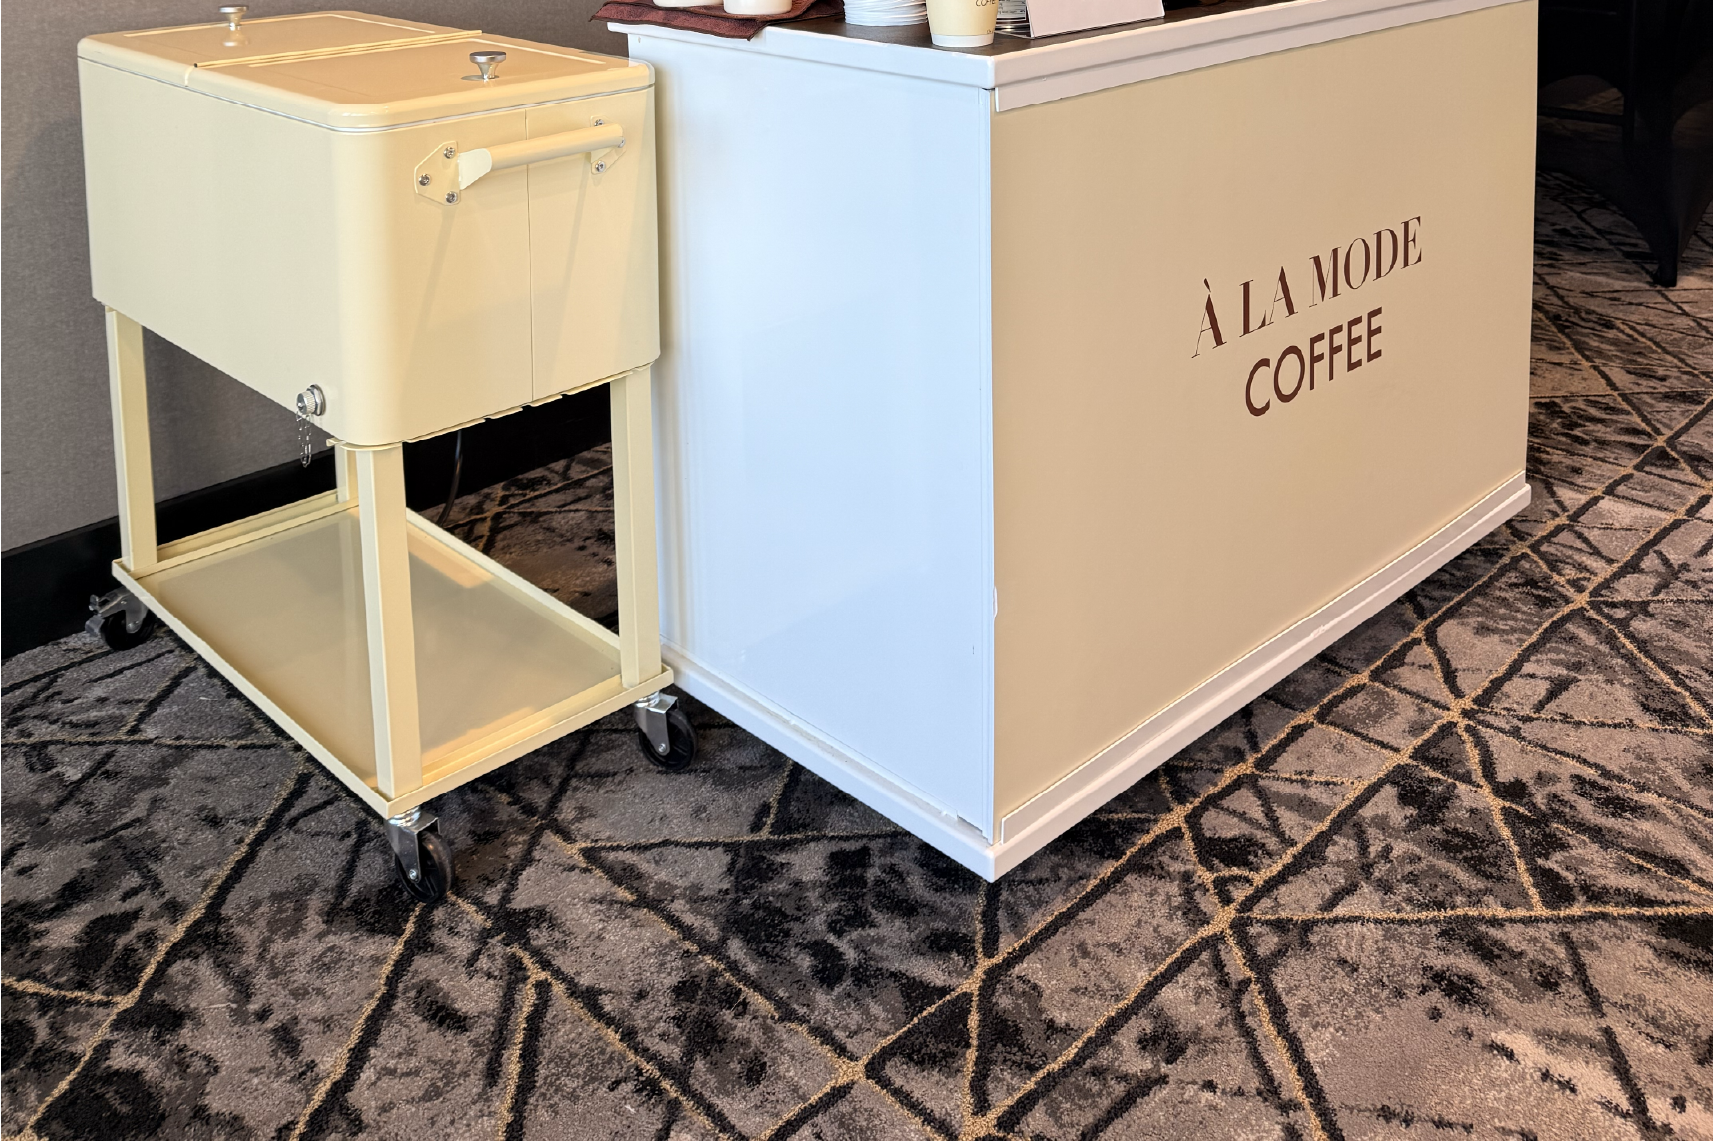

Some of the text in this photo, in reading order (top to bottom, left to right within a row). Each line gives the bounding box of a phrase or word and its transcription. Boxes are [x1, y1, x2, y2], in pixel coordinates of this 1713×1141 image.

[1191, 215, 1423, 359] À LA MODE
[1245, 306, 1383, 417] COFFEE
